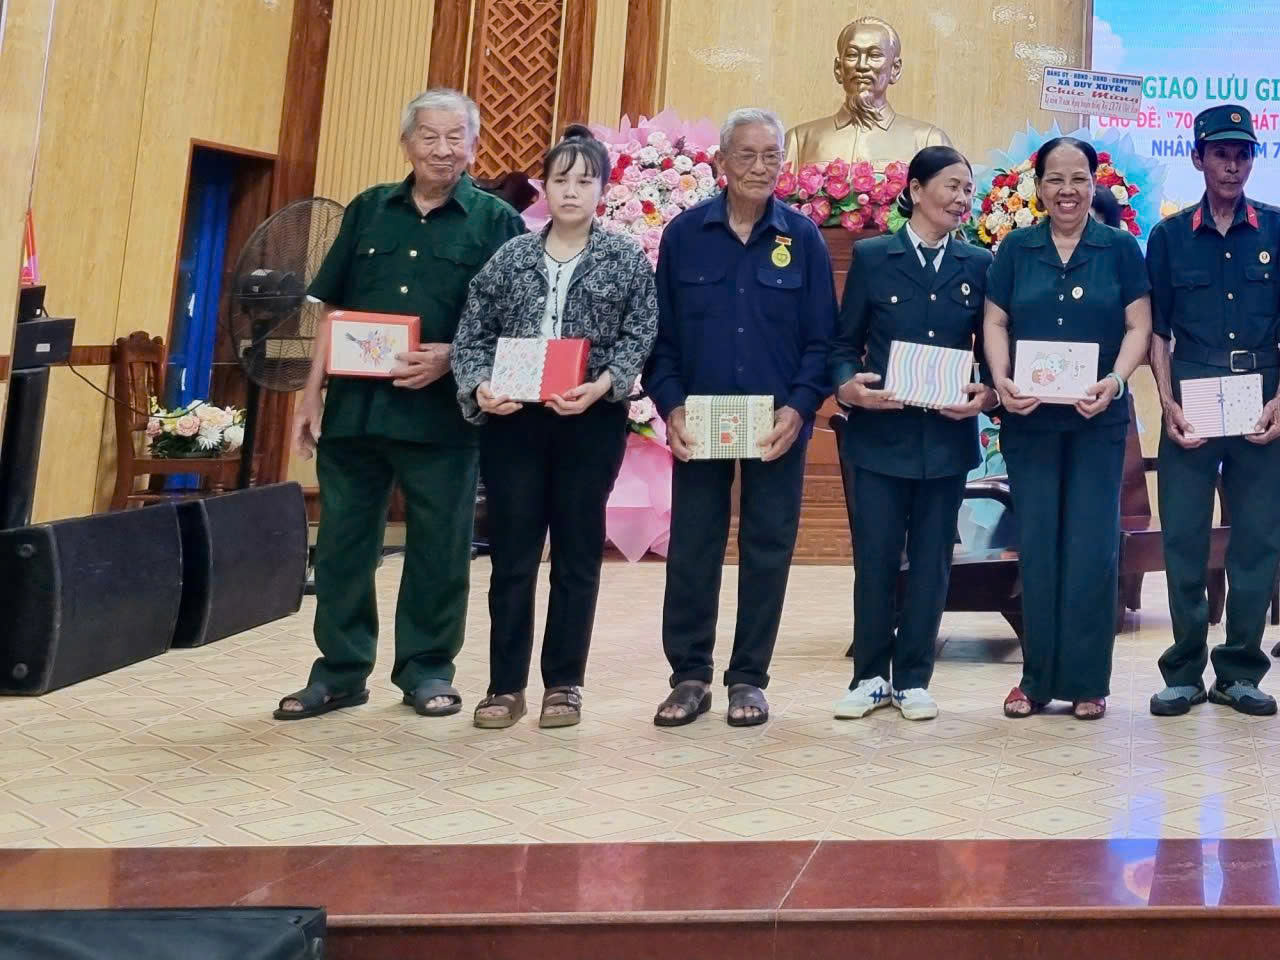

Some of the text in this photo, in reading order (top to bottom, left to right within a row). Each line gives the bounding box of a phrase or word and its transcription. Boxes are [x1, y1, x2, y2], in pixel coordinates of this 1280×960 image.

[1073, 80, 1093, 89] DUY
[1142, 76, 1199, 100] GIAO
[1205, 73, 1248, 100] LƯU
[1136, 106, 1161, 129] ĐỀ:
[1253, 107, 1279, 130] HÁT
